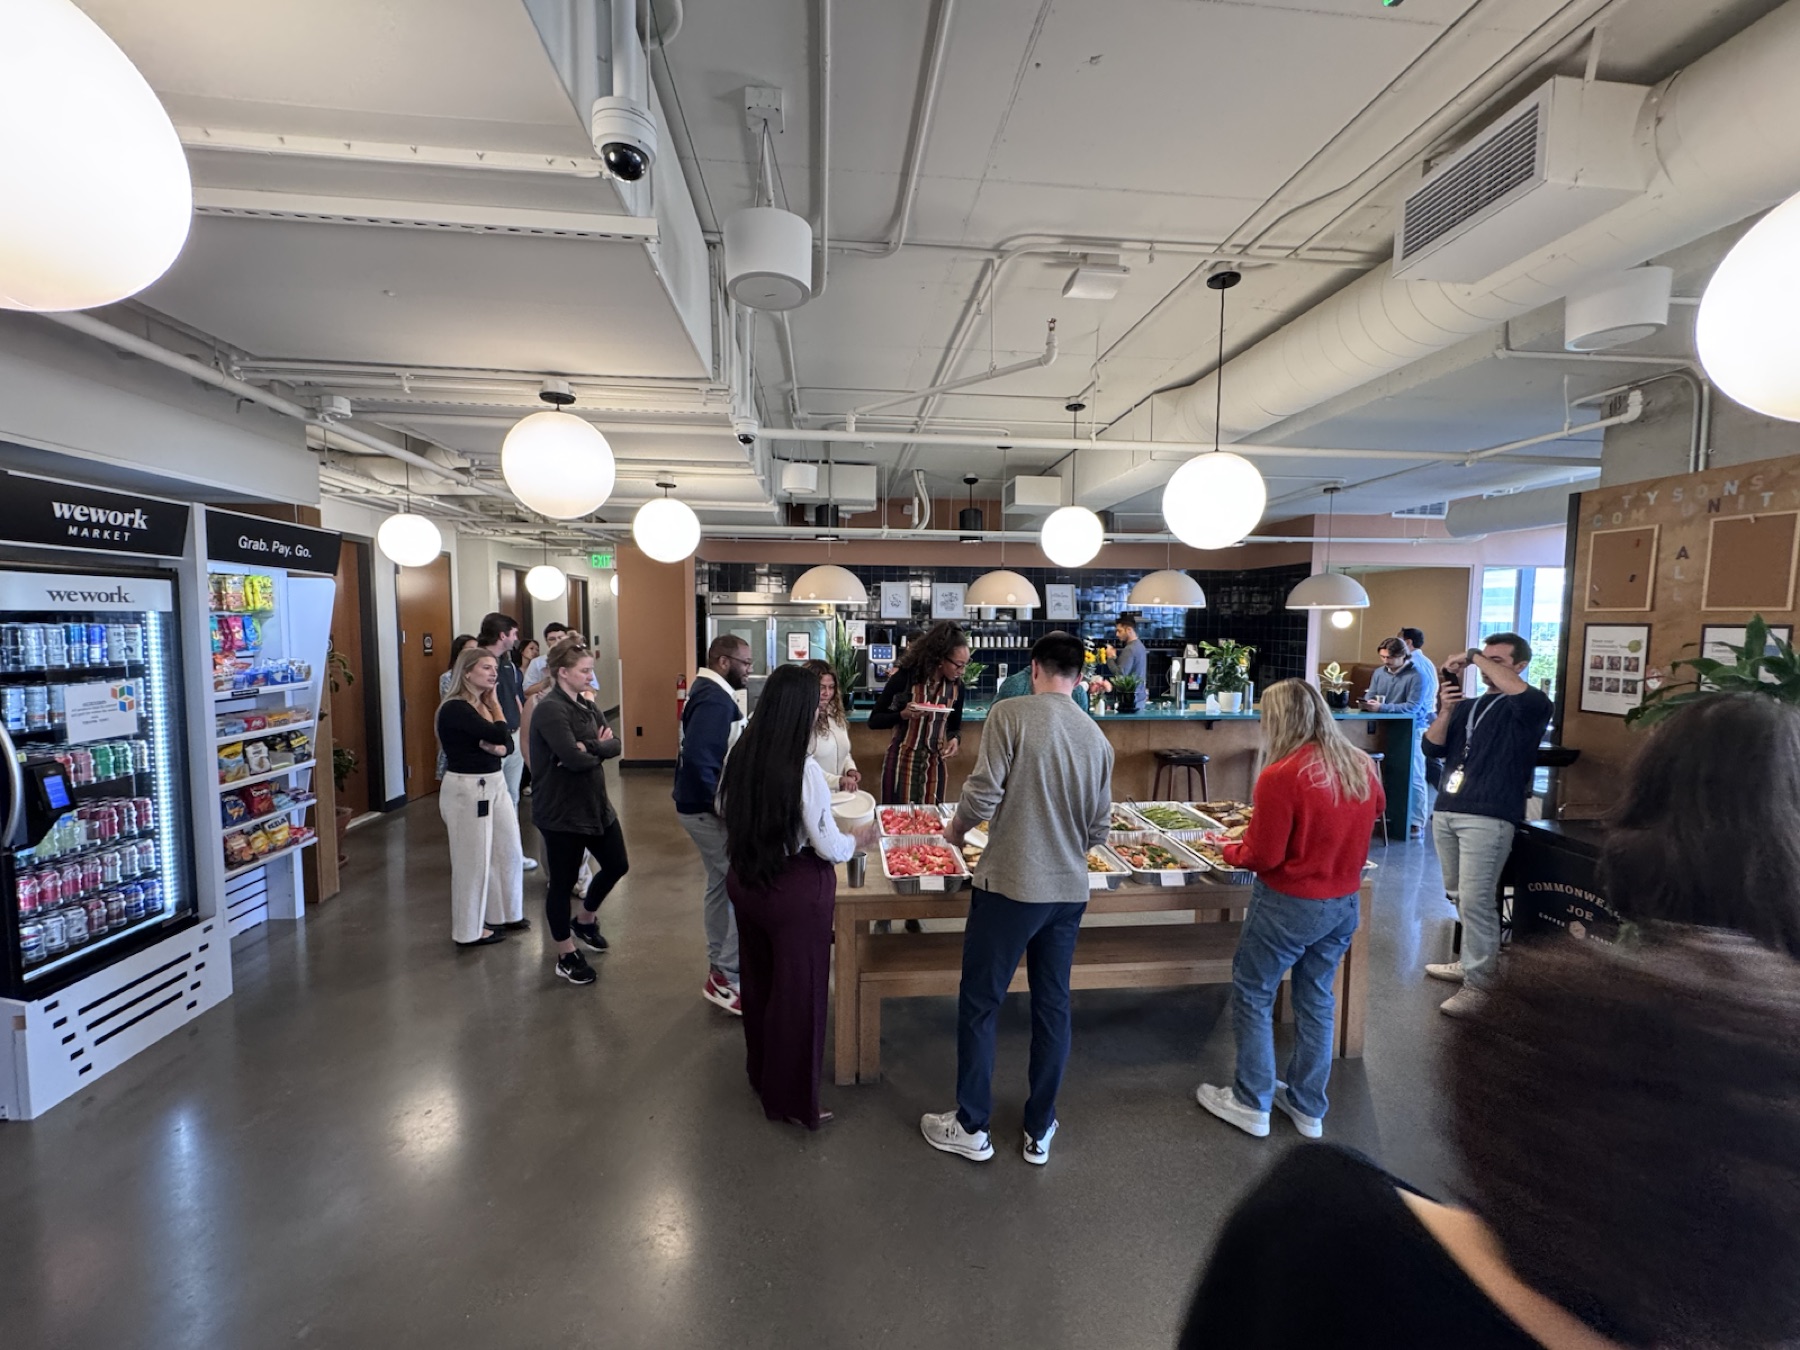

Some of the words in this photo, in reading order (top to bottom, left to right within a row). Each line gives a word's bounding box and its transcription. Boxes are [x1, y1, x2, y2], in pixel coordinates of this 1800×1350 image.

[1622, 475, 1764, 509] TYSONS
[52, 501, 149, 530] wework
[68, 525, 131, 541] MARKET
[238, 535, 269, 551] Grab.
[271, 540, 292, 557] Pay.
[295, 544, 312, 558] Go.
[592, 554, 611, 568] EXIT
[46, 585, 131, 603] wework
[1528, 882, 1621, 919] COMMONWE
[1566, 904, 1594, 922] JOE
